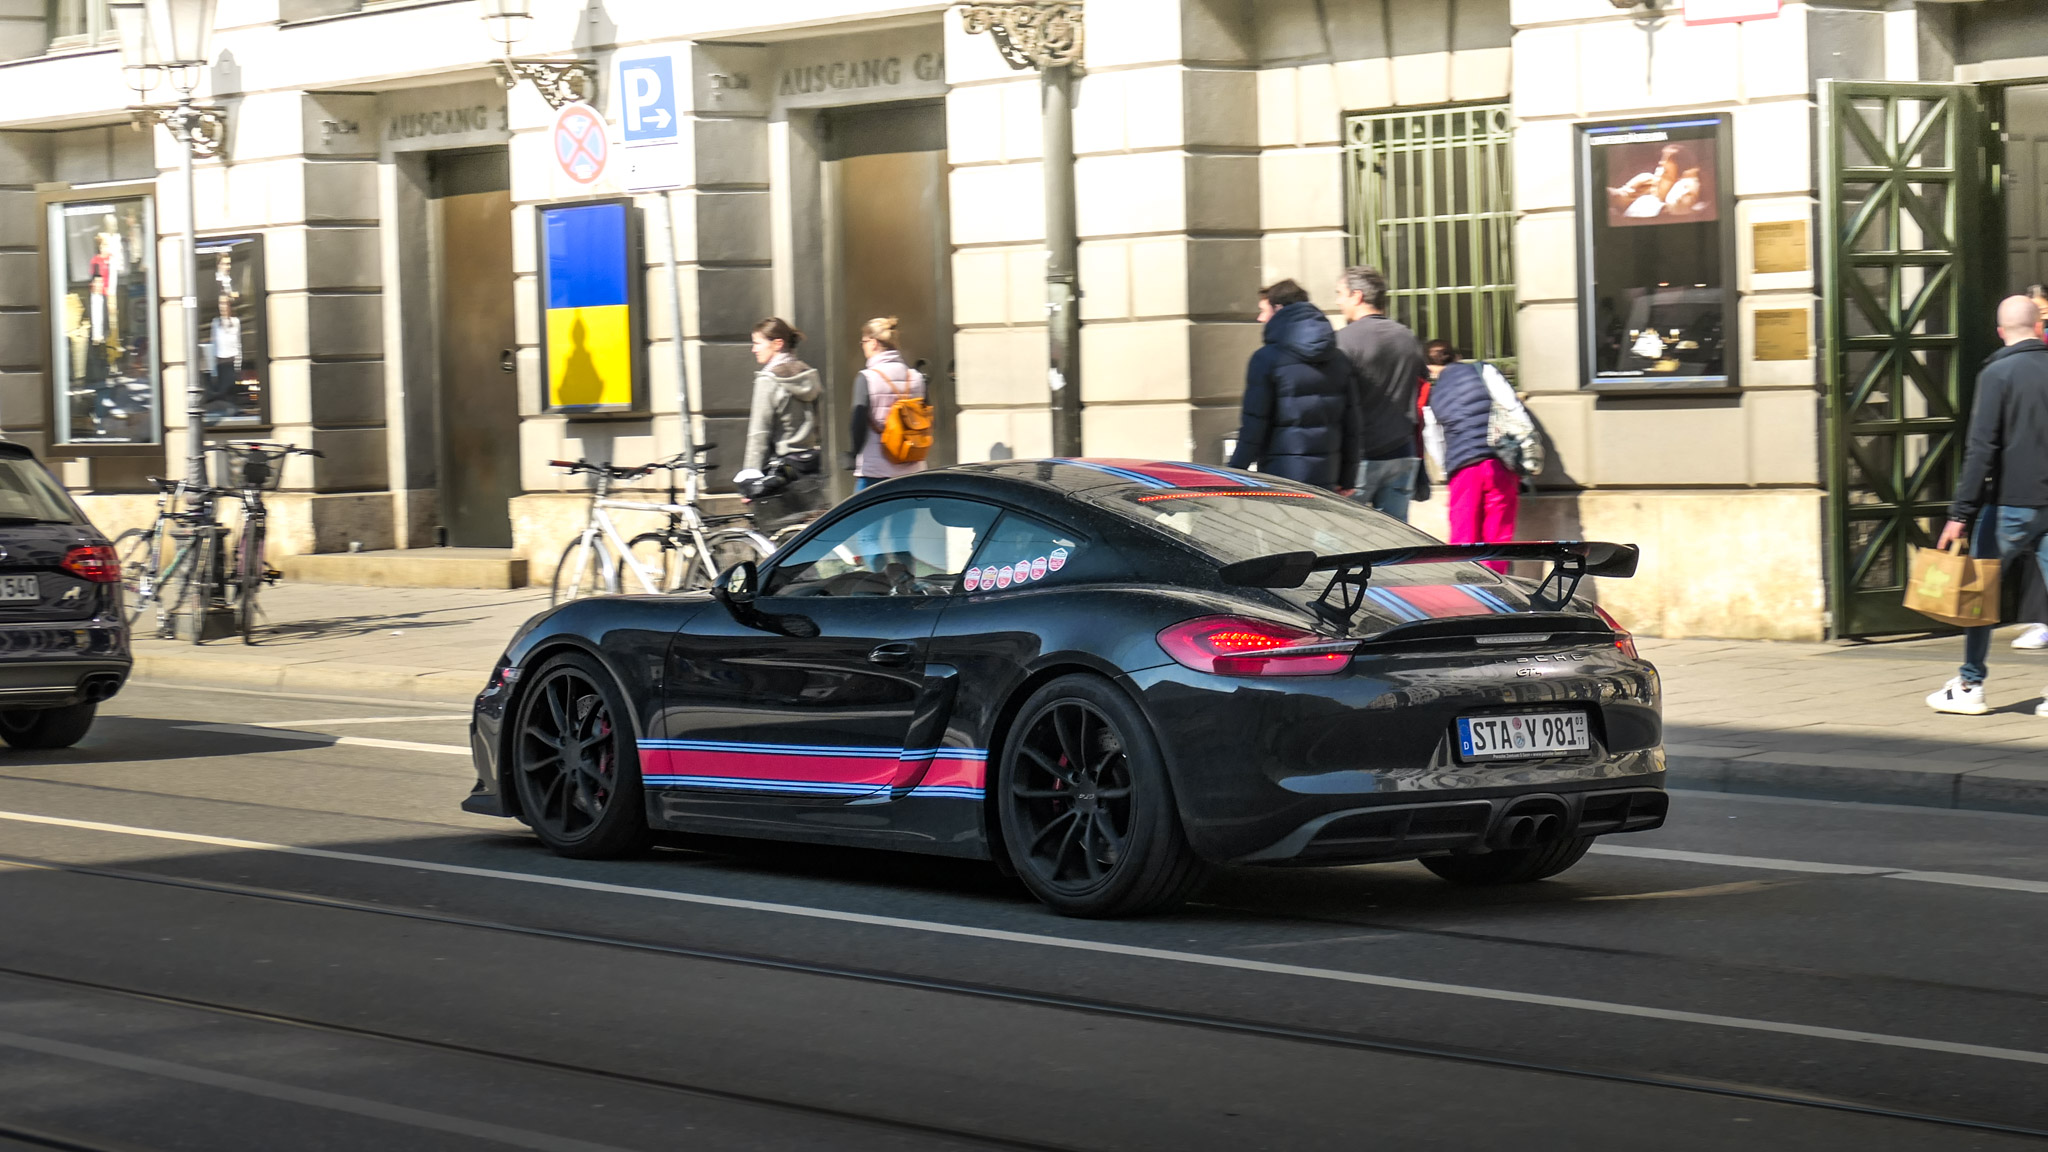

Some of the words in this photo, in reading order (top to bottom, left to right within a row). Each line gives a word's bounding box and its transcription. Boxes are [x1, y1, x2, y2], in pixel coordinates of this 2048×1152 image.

[779, 57, 900, 96] AUSGANG
[624, 68, 661, 131] P
[388, 105, 487, 141] AUSGANG
[5, 578, 37, 598] 540
[1463, 741, 1470, 750] D
[1472, 721, 1513, 751] STA
[1525, 718, 1537, 748] Y
[1542, 716, 1577, 747] 981
